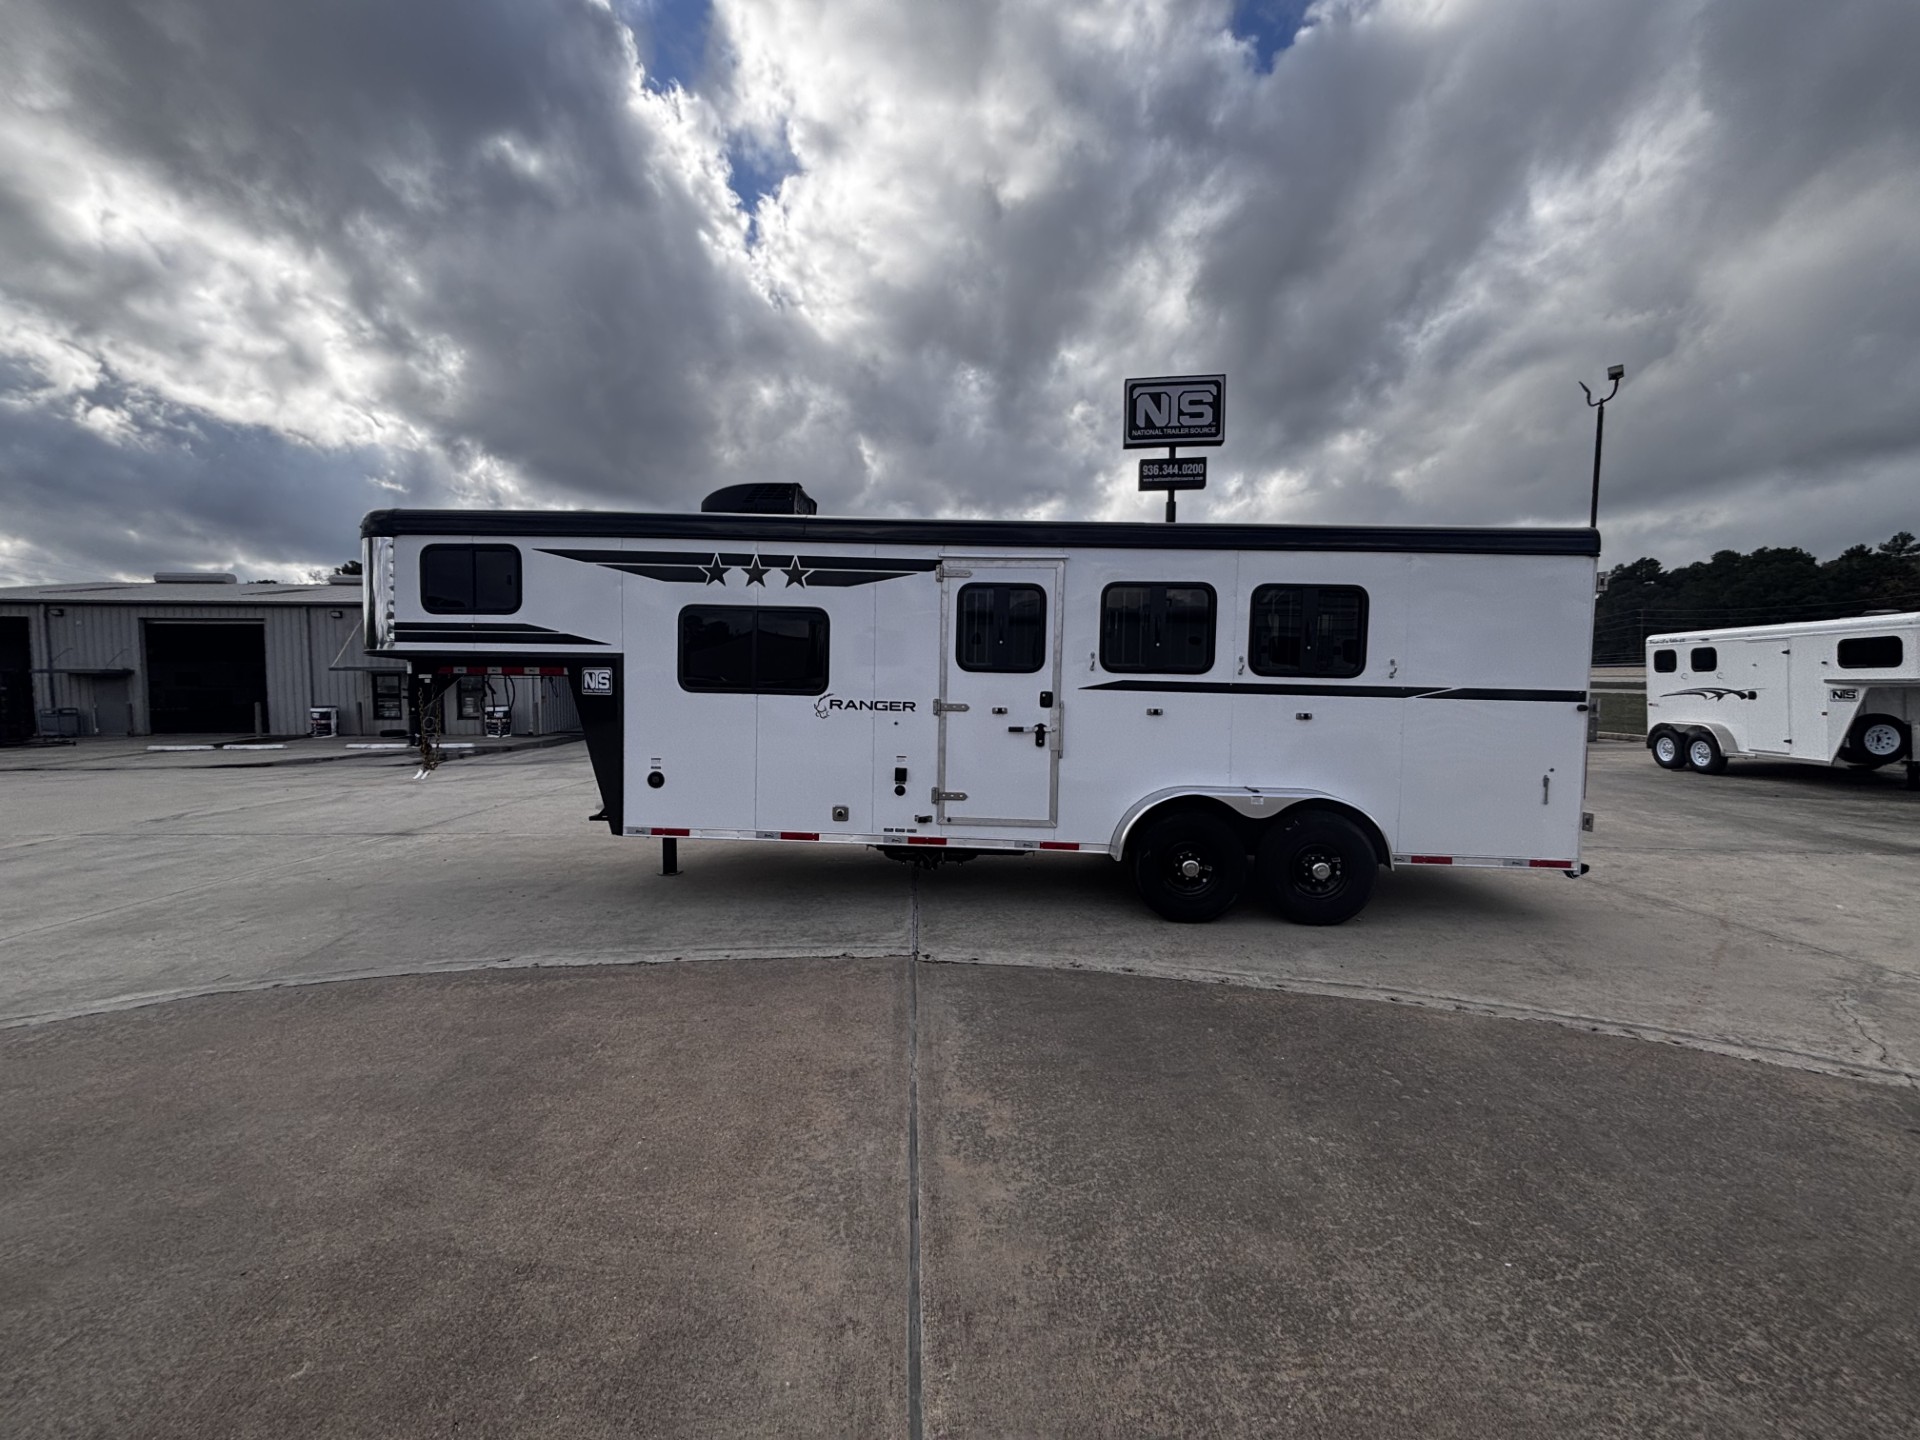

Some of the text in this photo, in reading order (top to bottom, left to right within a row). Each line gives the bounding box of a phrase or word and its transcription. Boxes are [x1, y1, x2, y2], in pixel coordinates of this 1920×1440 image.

[1132, 384, 1217, 427] NTS
[1142, 463, 1204, 475] 936.344.0200
[829, 699, 917, 712] RANGER
